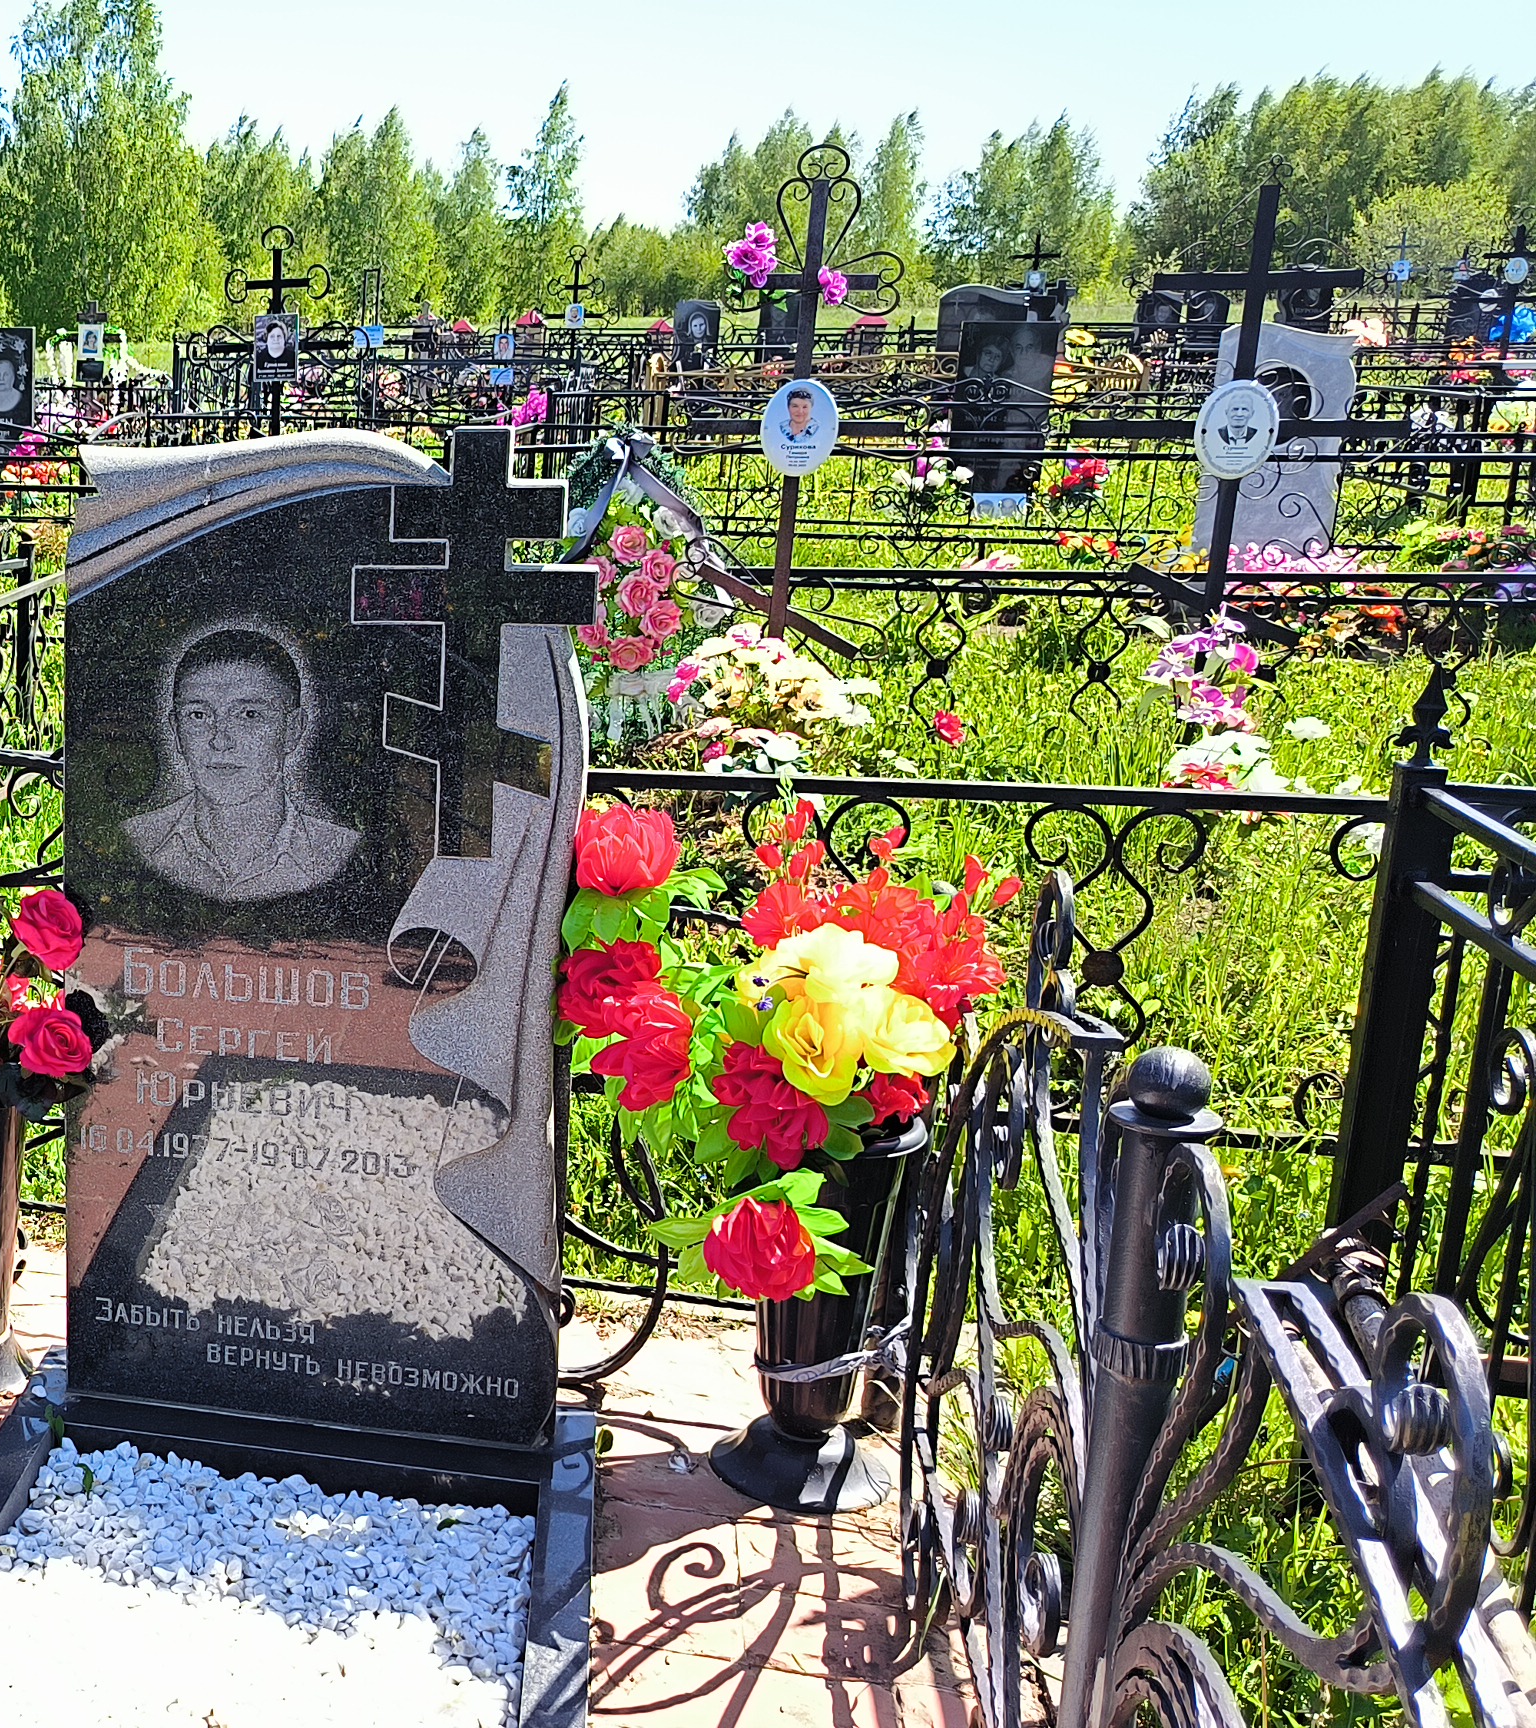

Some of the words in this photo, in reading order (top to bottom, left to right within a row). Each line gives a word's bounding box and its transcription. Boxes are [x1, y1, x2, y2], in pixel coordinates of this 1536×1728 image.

[123, 947, 370, 1010] БОЛЬШОВ
[155, 1017, 332, 1064] СЕРГЕЙ
[136, 1070, 352, 1122] ЮРЬЕВИЧ
[95, 1296, 201, 1332] ЗАБЫТЬ
[217, 1316, 316, 1345] НЕЛЬЗЯ
[206, 1342, 321, 1376] ВЕРНУТЬ
[338, 1359, 520, 1399] НЕВОЗМОЖНО
